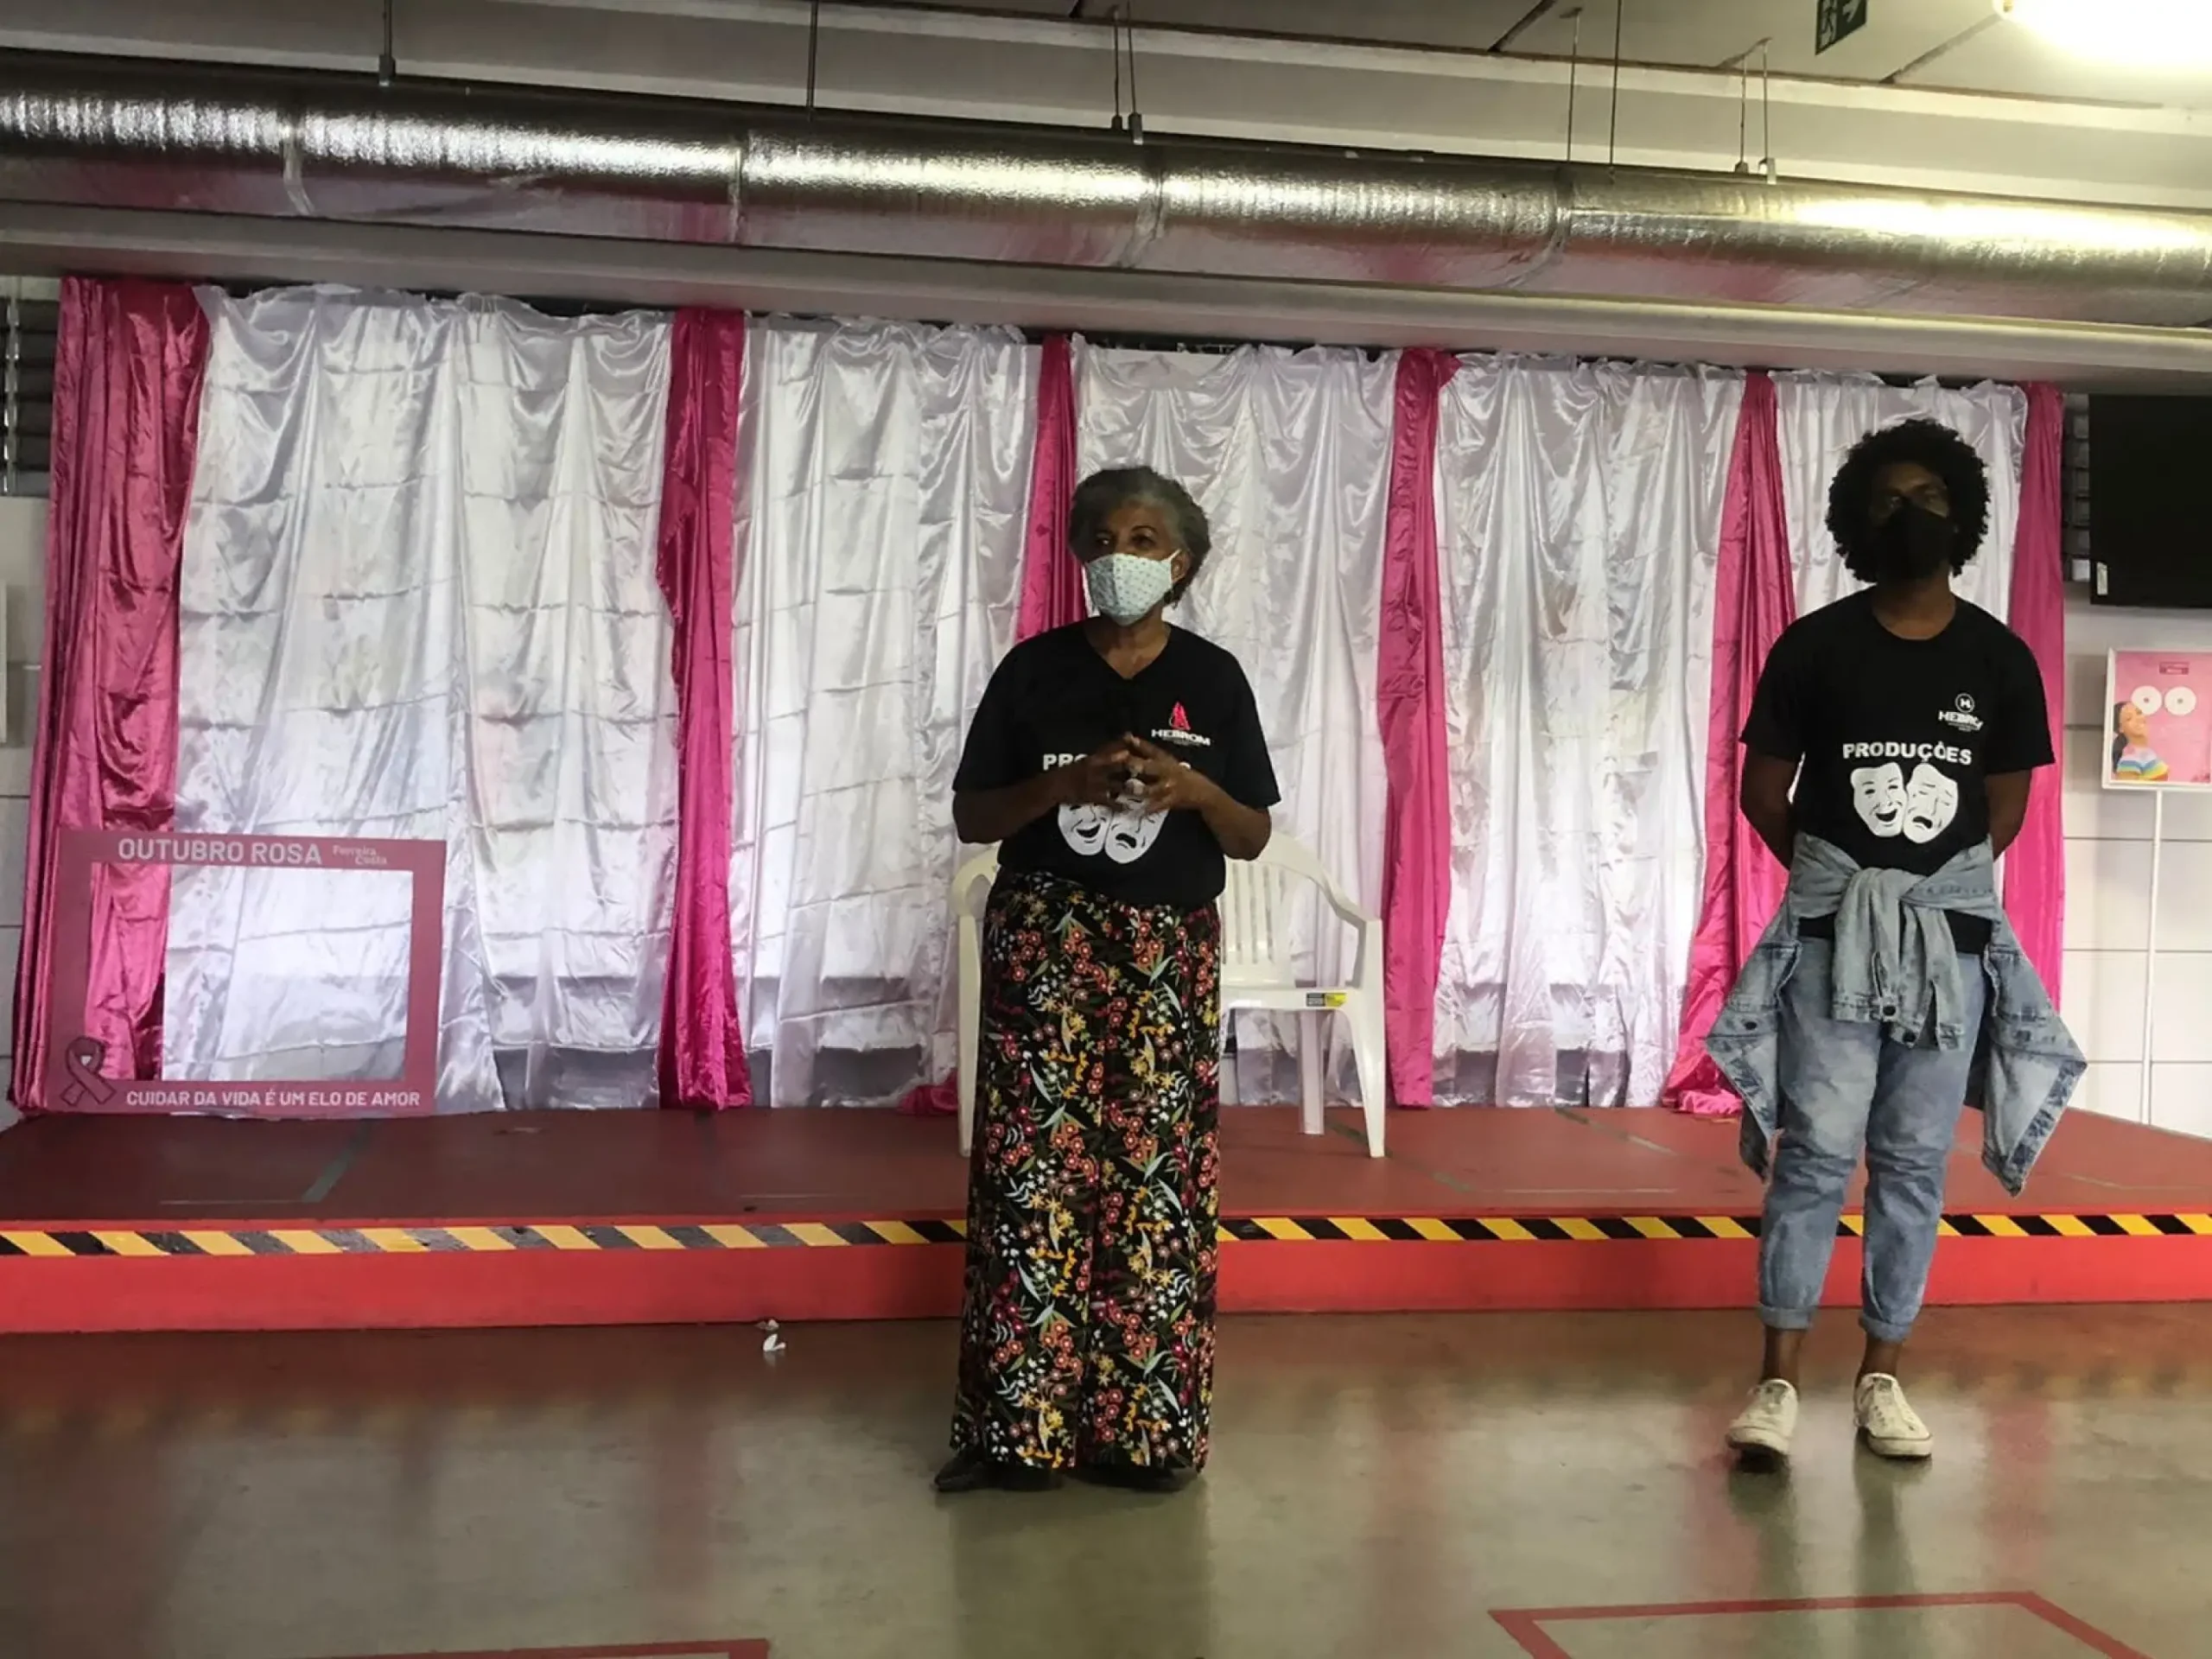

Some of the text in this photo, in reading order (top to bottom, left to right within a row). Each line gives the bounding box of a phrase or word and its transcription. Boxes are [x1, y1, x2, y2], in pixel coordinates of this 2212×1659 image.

[1842, 740, 1973, 765] PRODUÇÕES
[118, 837, 322, 865] OUTUBRO ROSA
[126, 1088, 420, 1106] CUIDAR DA VIDA É UM ELO DE AMOR
